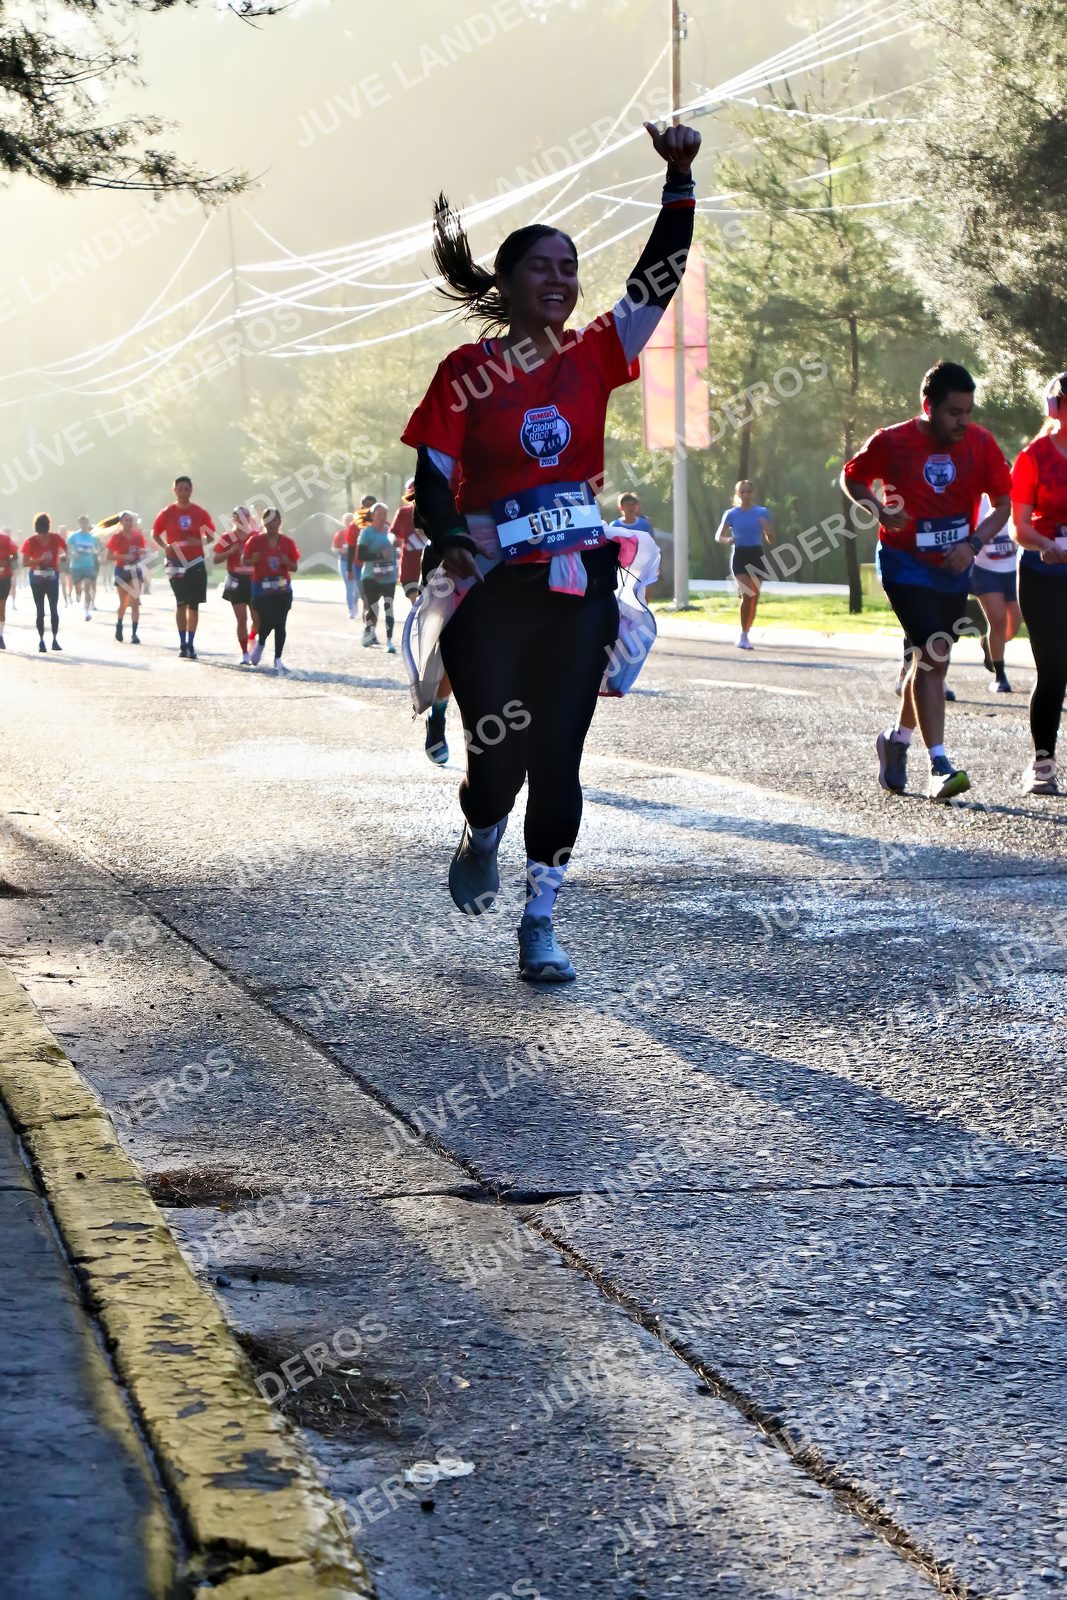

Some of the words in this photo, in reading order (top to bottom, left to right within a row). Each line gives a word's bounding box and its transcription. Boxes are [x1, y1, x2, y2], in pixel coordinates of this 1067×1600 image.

[532, 420, 557, 433] Global
[530, 431, 550, 442] Race
[541, 457, 557, 466] 2026
[527, 508, 575, 536] 5672
[934, 530, 958, 545] 5644
